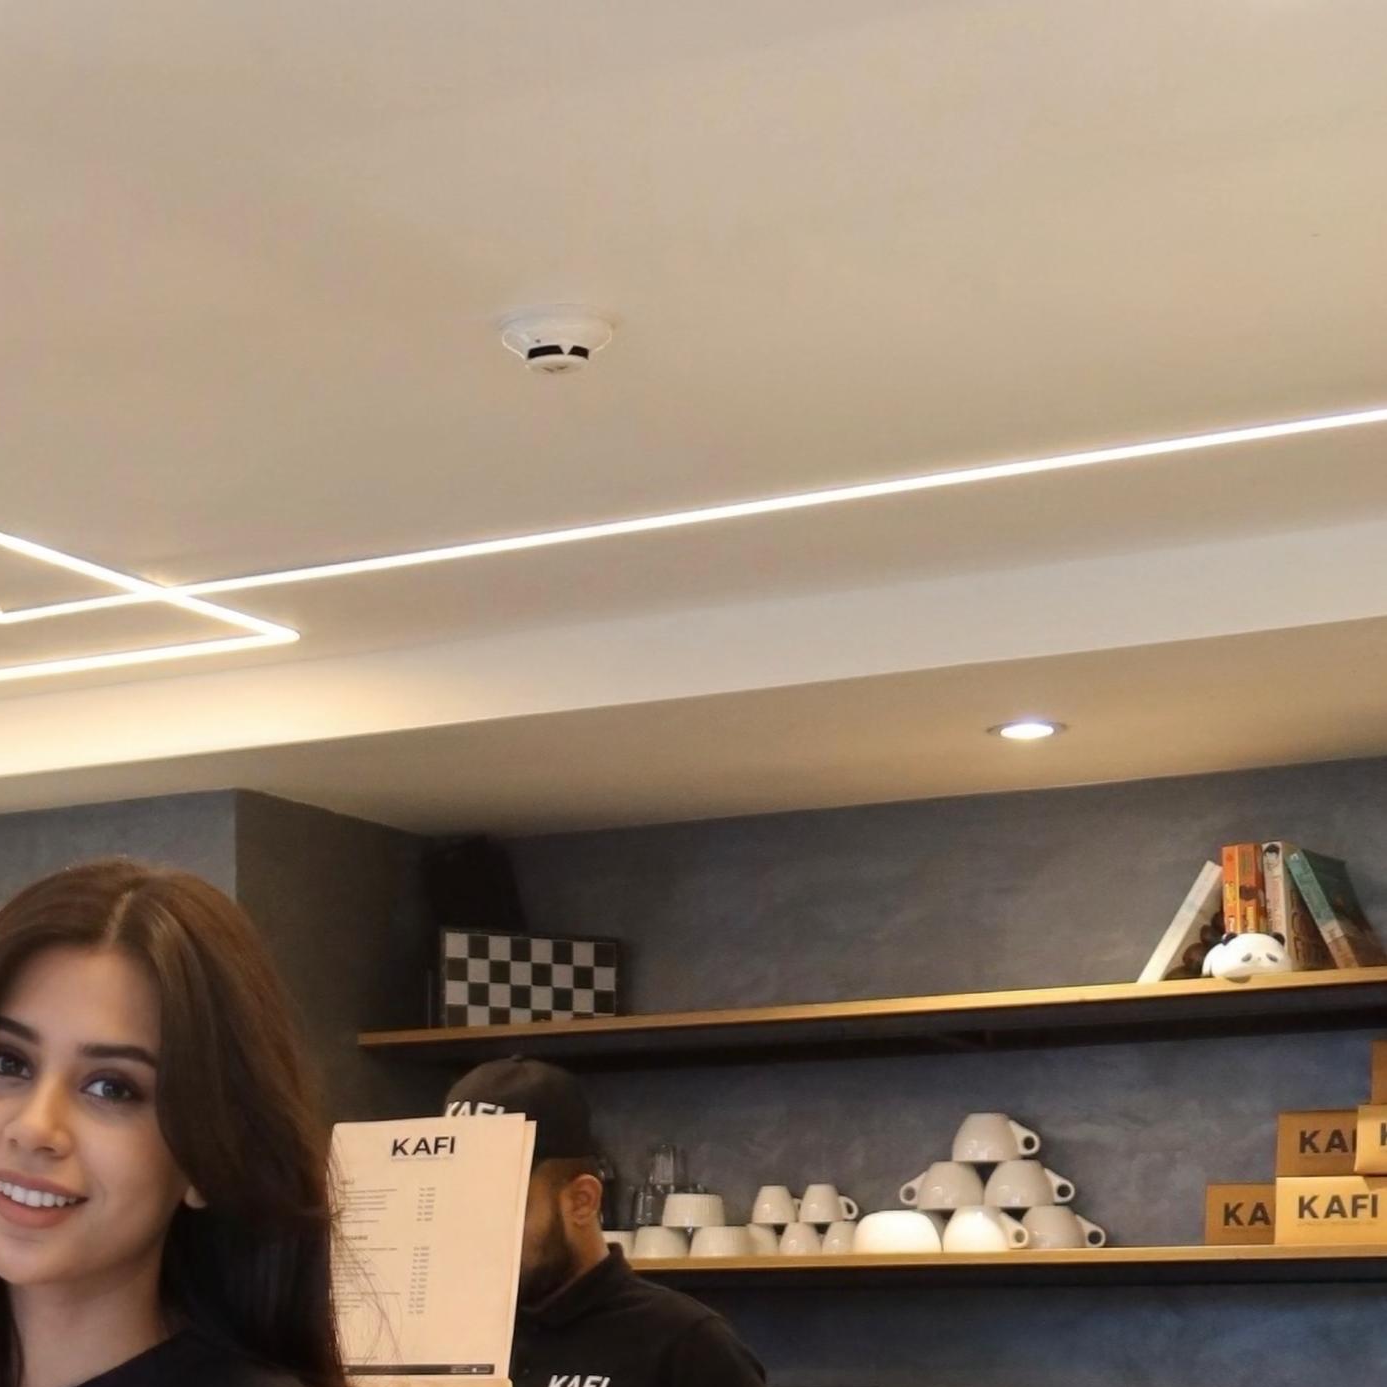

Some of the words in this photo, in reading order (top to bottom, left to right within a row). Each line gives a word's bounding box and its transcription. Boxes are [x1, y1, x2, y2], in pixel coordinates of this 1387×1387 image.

[391, 1136, 456, 1157] KAFI
[1299, 1129, 1357, 1154] KA
[1223, 1202, 1272, 1227] KA
[1297, 1194, 1379, 1219] KAFI
